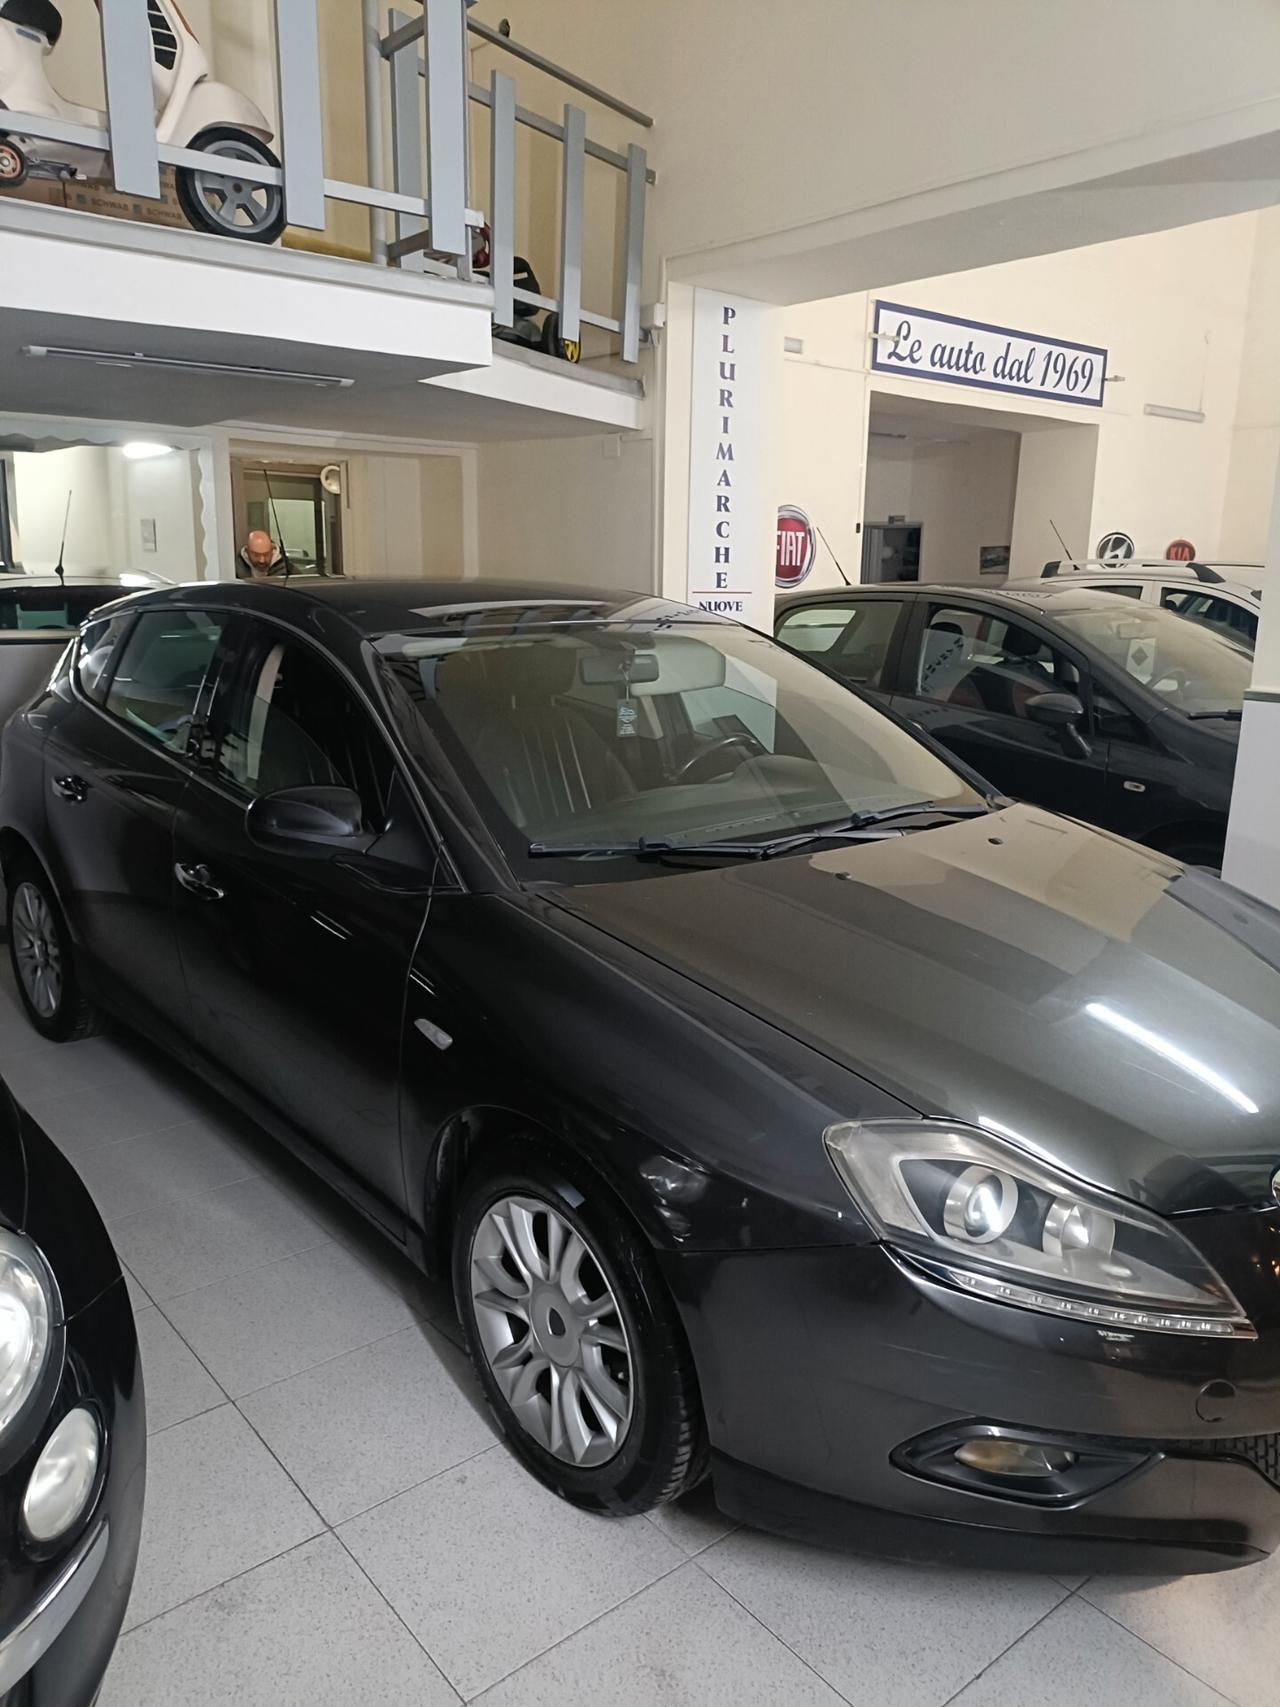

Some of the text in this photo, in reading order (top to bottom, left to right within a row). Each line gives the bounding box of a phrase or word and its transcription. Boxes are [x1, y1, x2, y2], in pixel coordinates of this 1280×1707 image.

[887, 320, 1094, 394] Le auto dal 1969
[714, 306, 736, 589] PLURIMARCHE
[699, 601, 743, 612] NUOVE
